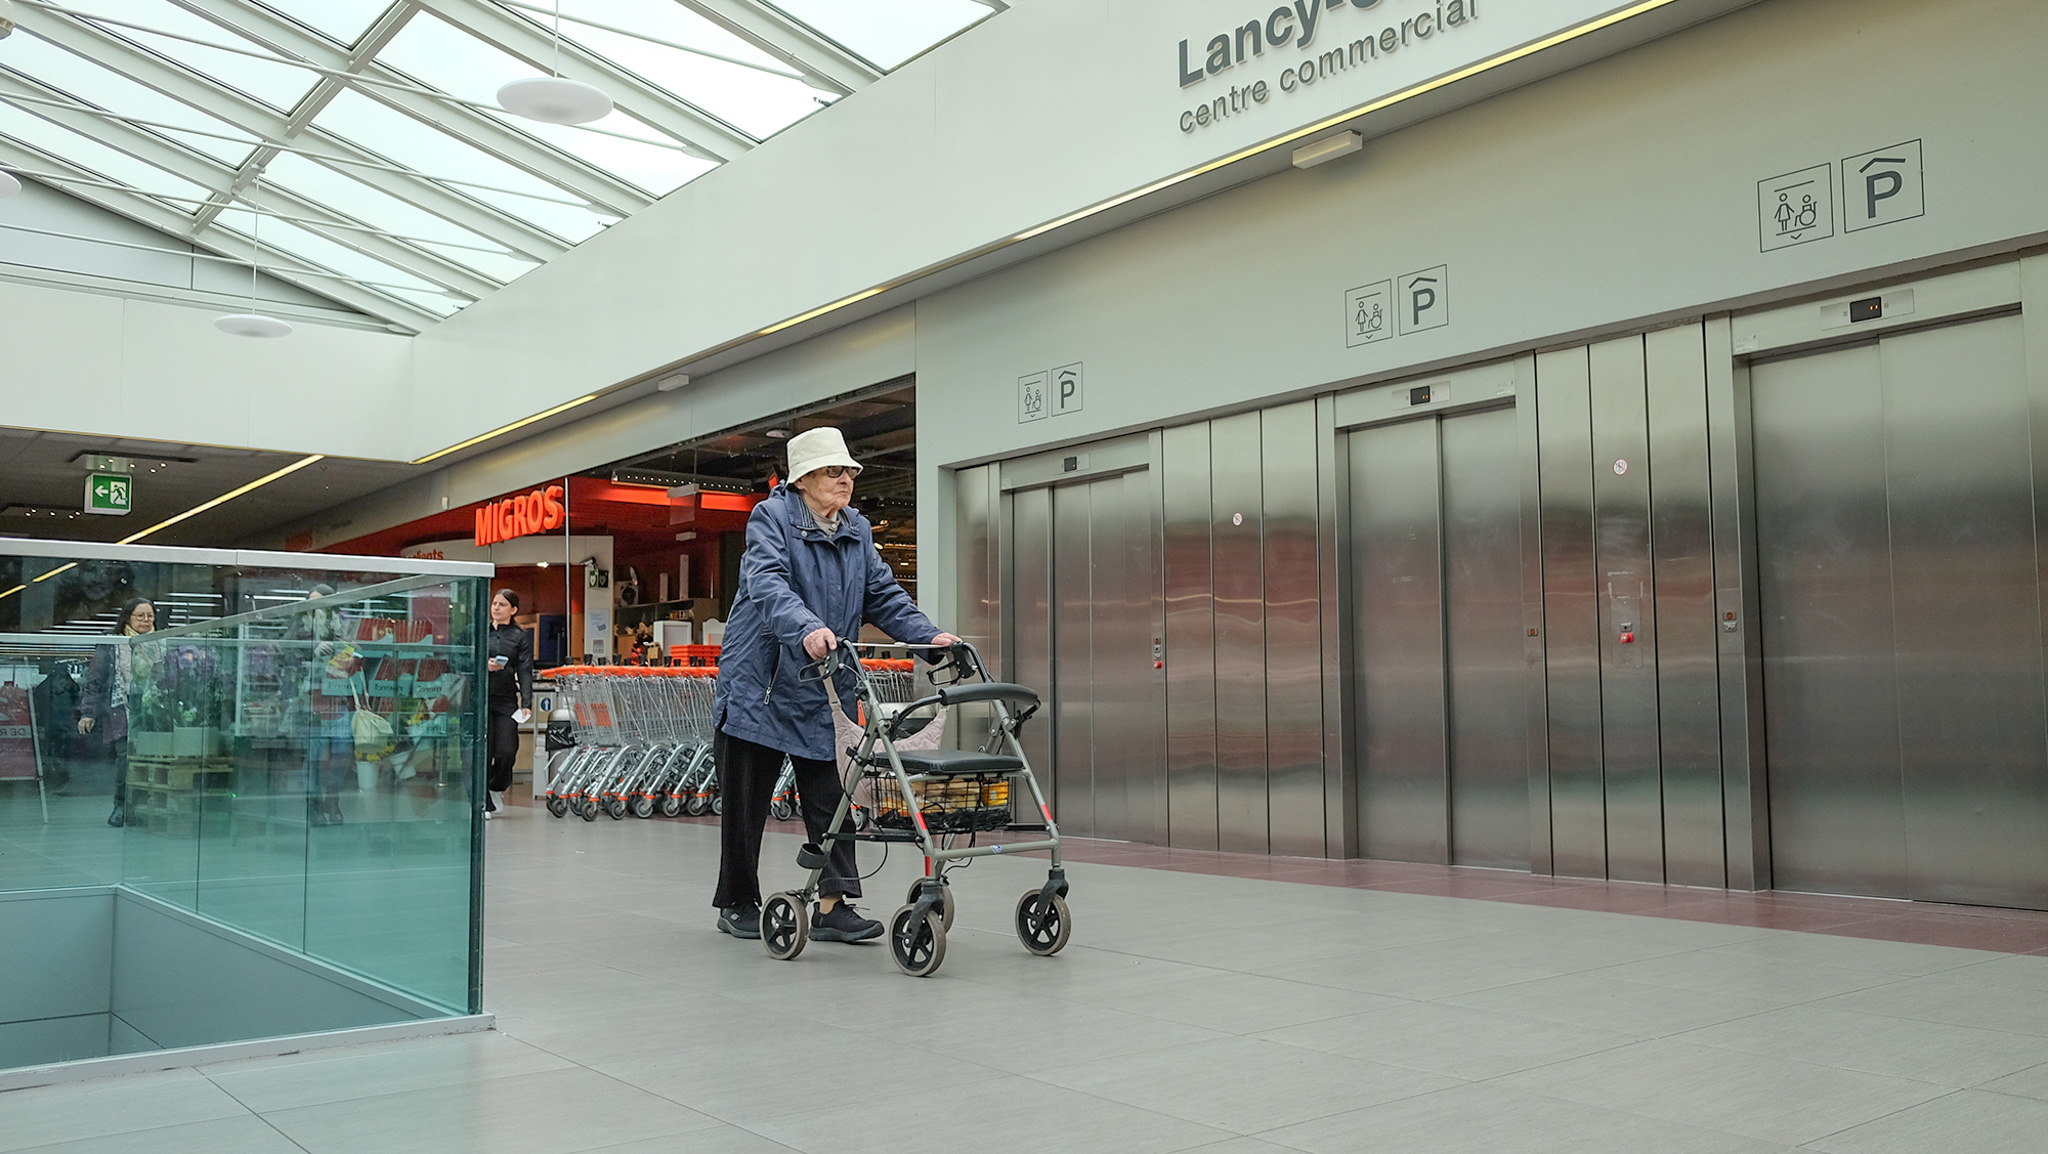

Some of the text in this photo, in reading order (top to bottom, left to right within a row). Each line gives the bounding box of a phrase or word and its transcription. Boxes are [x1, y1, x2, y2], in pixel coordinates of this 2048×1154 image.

[1179, 0, 1382, 87] Lancy-
[1179, 79, 1269, 133] centre
[1866, 170, 1902, 219] P
[1413, 288, 1435, 325] P
[1061, 380, 1075, 408] P
[474, 485, 565, 547] MIGROS
